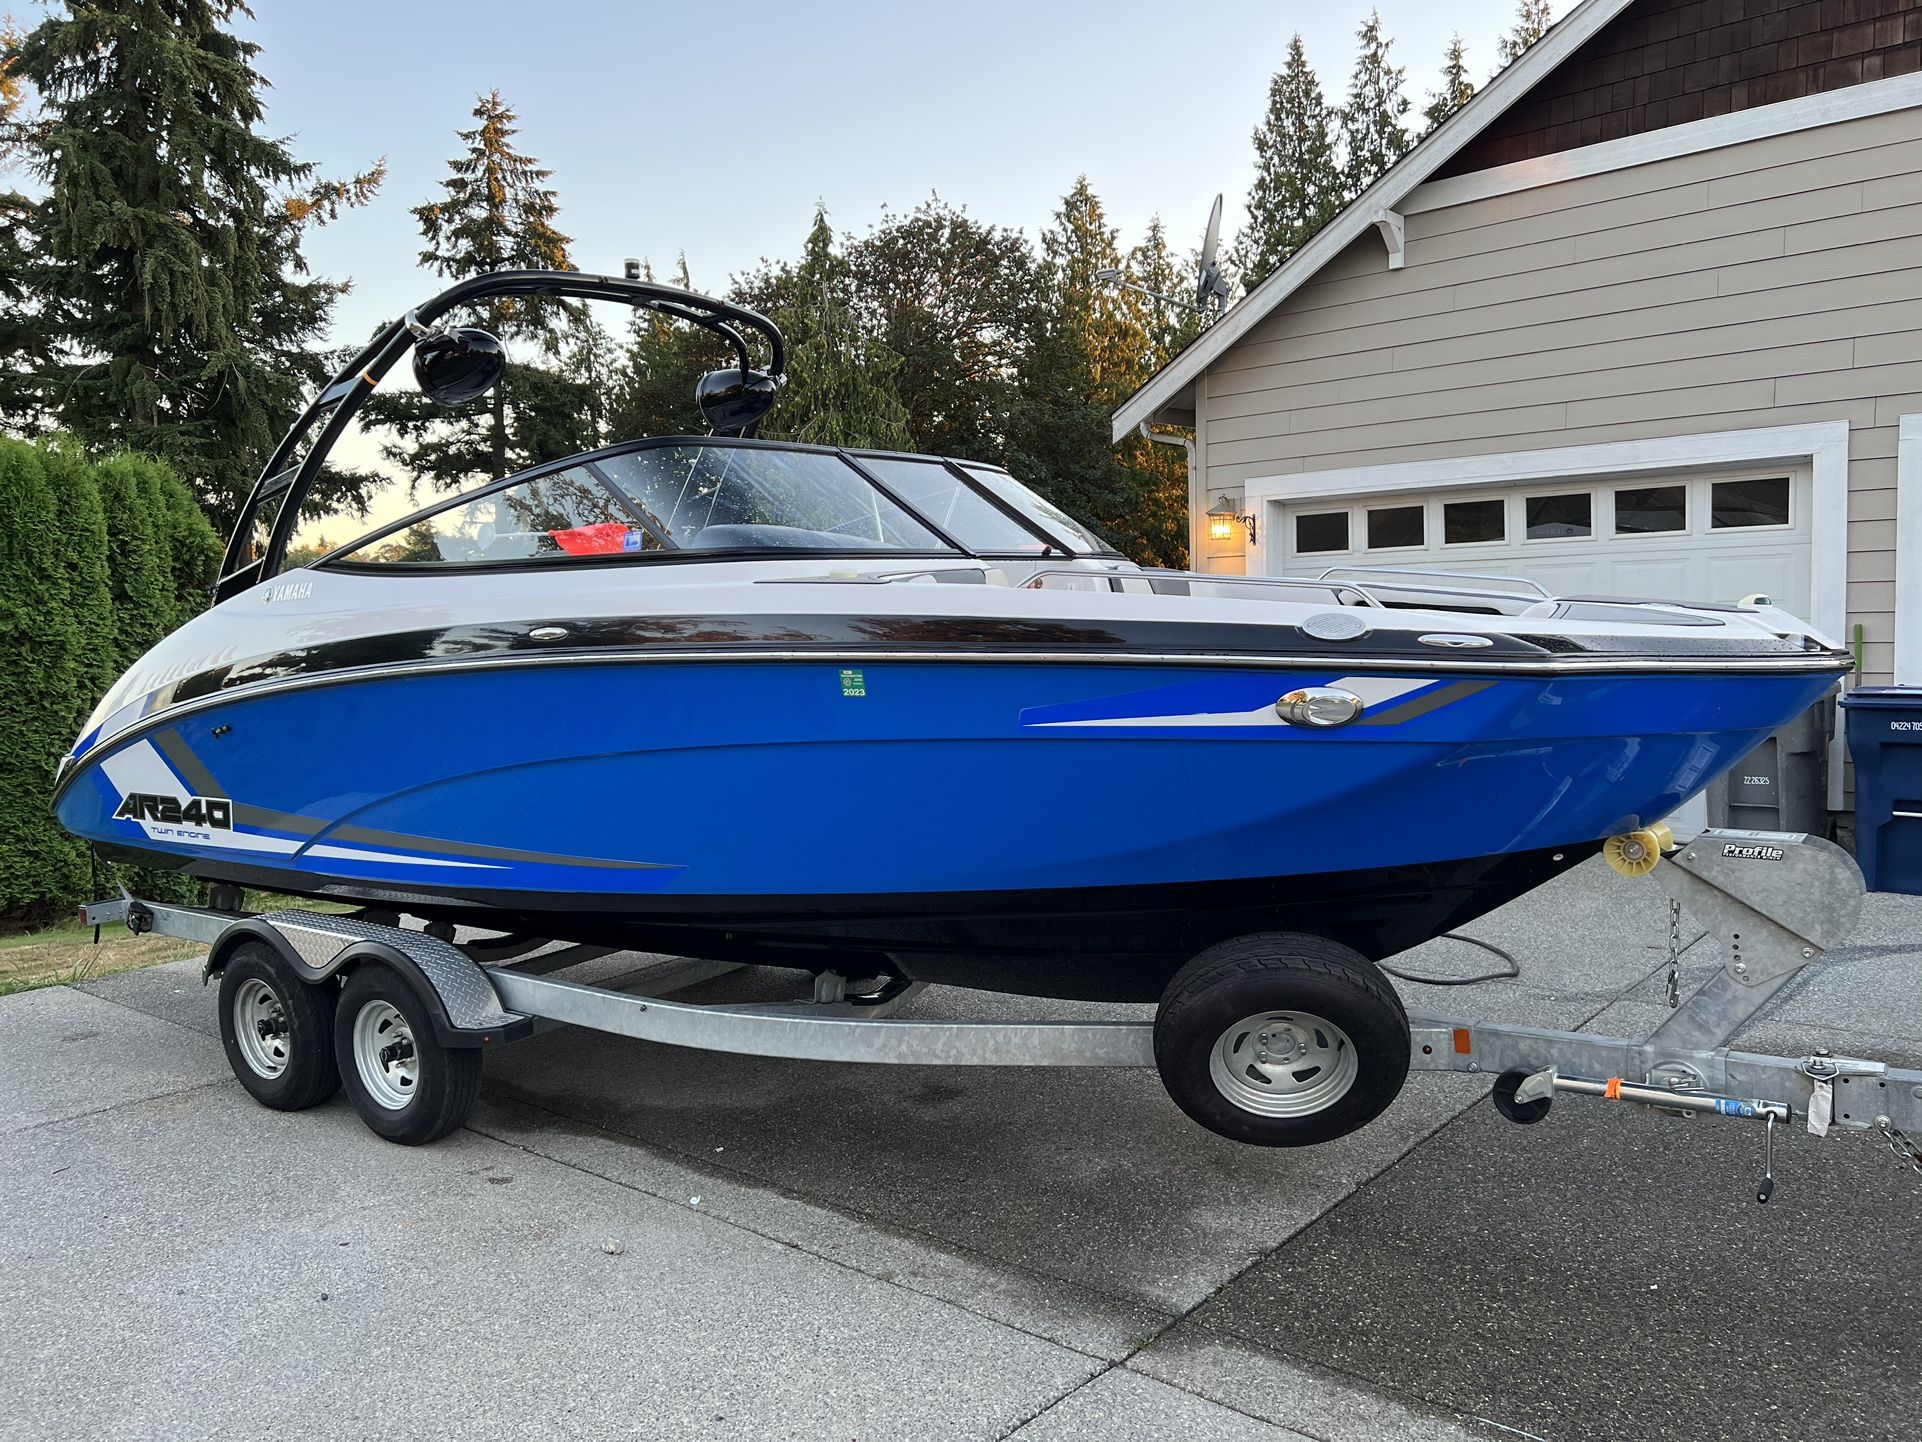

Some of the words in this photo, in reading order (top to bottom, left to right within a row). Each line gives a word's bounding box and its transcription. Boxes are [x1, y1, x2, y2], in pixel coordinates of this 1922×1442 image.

[273, 582, 313, 601] YAMAHA
[843, 688, 866, 696] 2023
[1891, 721, 1911, 730] 04224
[115, 792, 232, 830] AR240
[151, 826, 174, 836] TWIN
[177, 830, 211, 840] ENGINE
[1723, 844, 1783, 857] Profile
